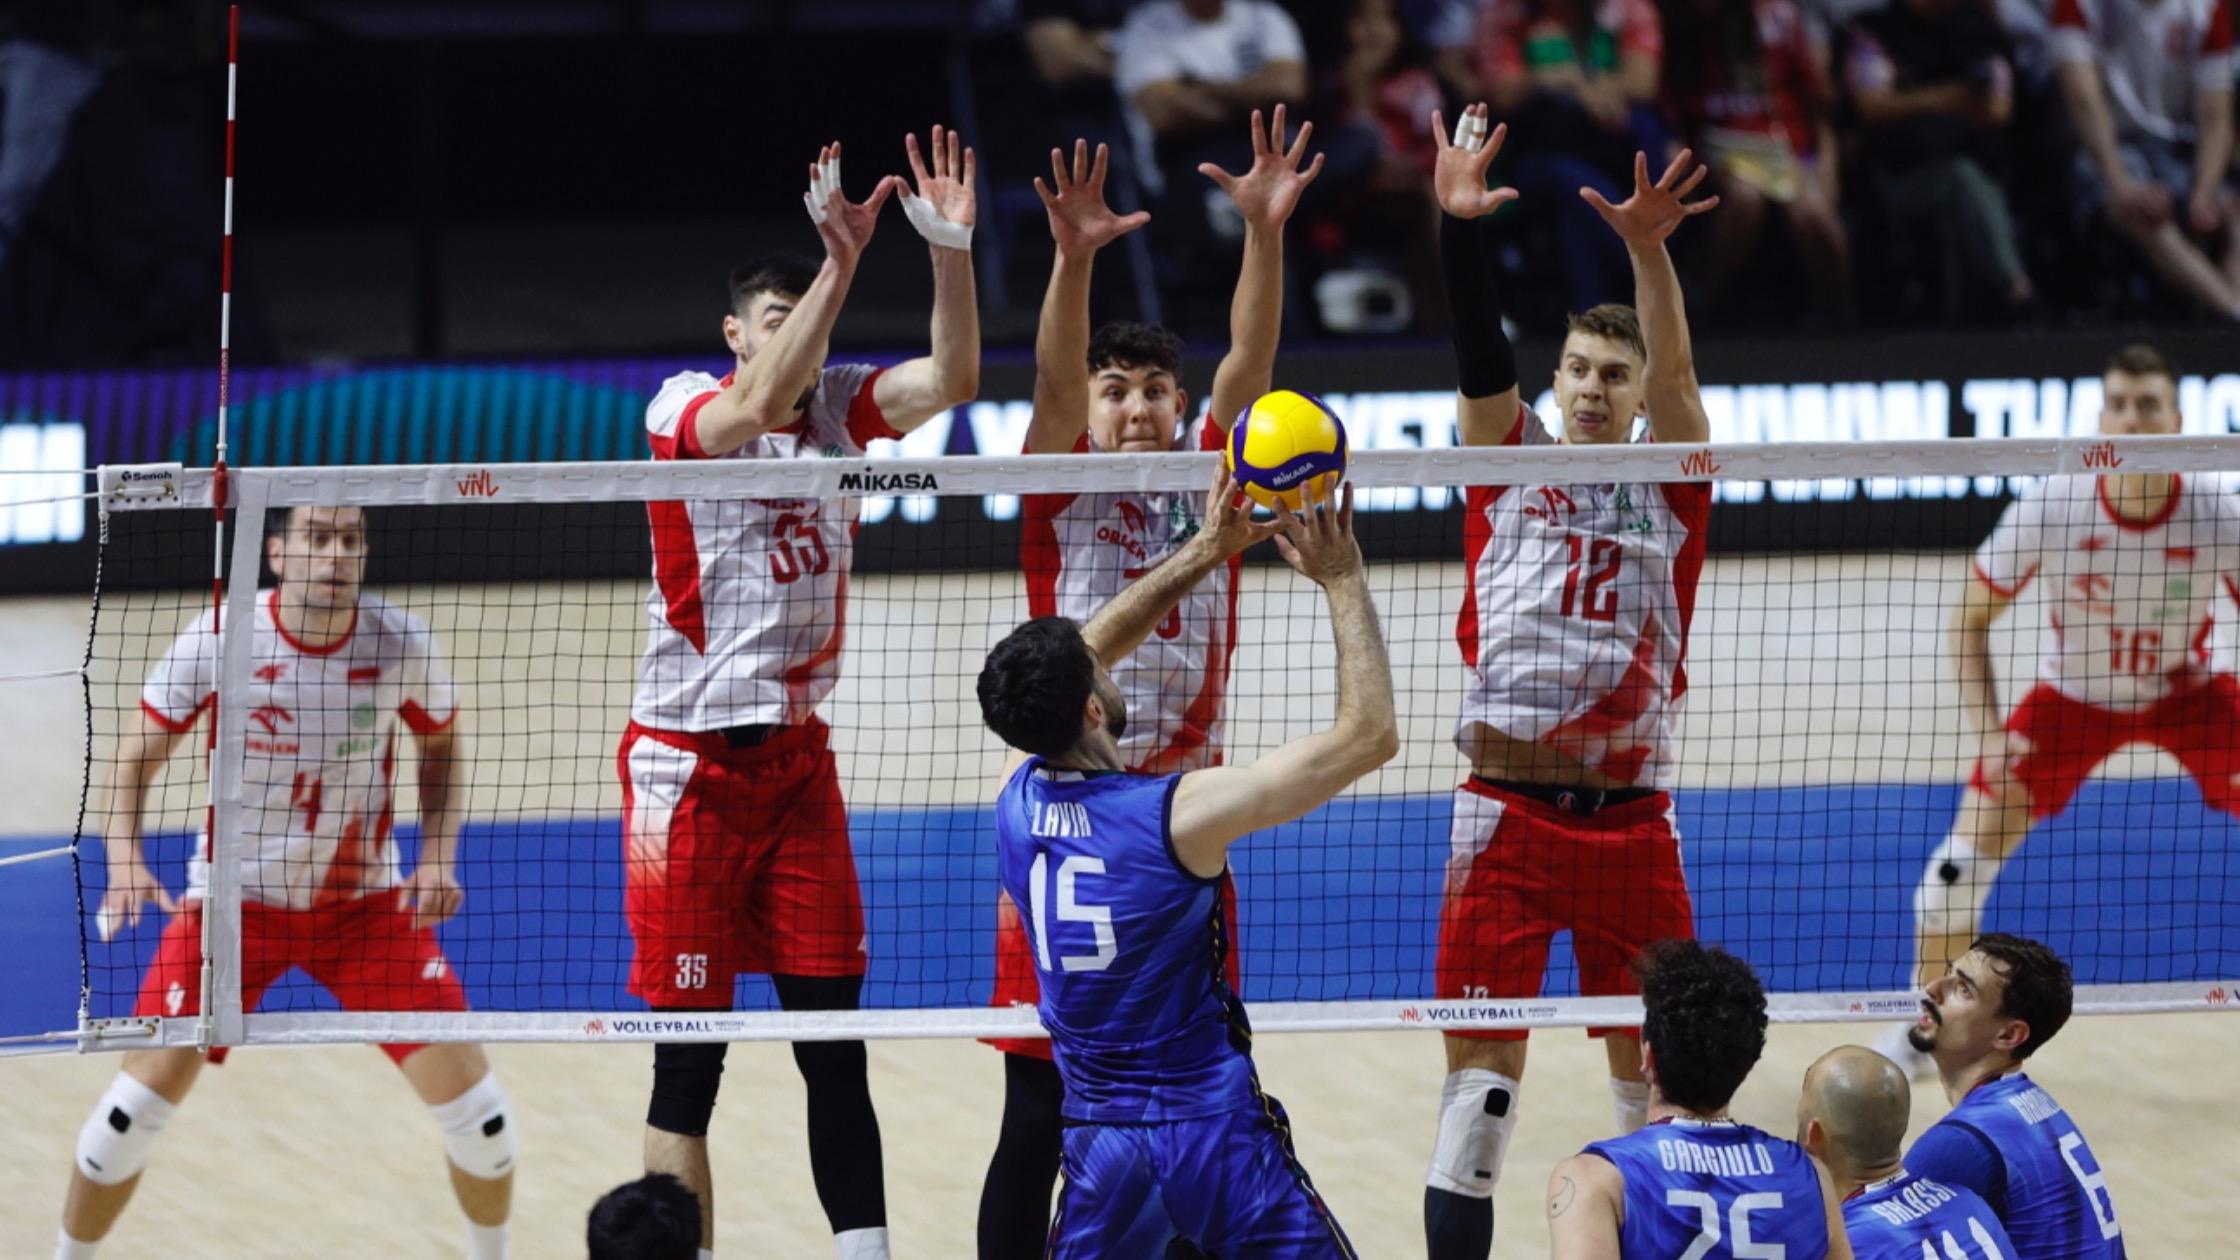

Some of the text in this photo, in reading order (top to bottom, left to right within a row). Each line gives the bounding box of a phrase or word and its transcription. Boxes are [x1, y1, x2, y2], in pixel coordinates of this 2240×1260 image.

[132, 471, 172, 481] Senoh
[838, 465, 938, 491] MIKASA
[1272, 462, 1314, 487] MIKASA
[1680, 448, 1720, 475] VNL
[1096, 526, 1147, 561] ORLEN
[1560, 534, 1623, 622] 12
[2111, 627, 2160, 673] 16
[291, 771, 323, 832] 4
[1030, 801, 1092, 838] LAVIA
[1028, 852, 1118, 972] 15
[675, 952, 708, 989] 35
[612, 1020, 713, 1034] VOLLEYBALL
[1427, 1008, 1525, 1020] VOLLEYBALL
[1658, 1139, 1774, 1177] GARGIULO
[2059, 1131, 2121, 1240] 6
